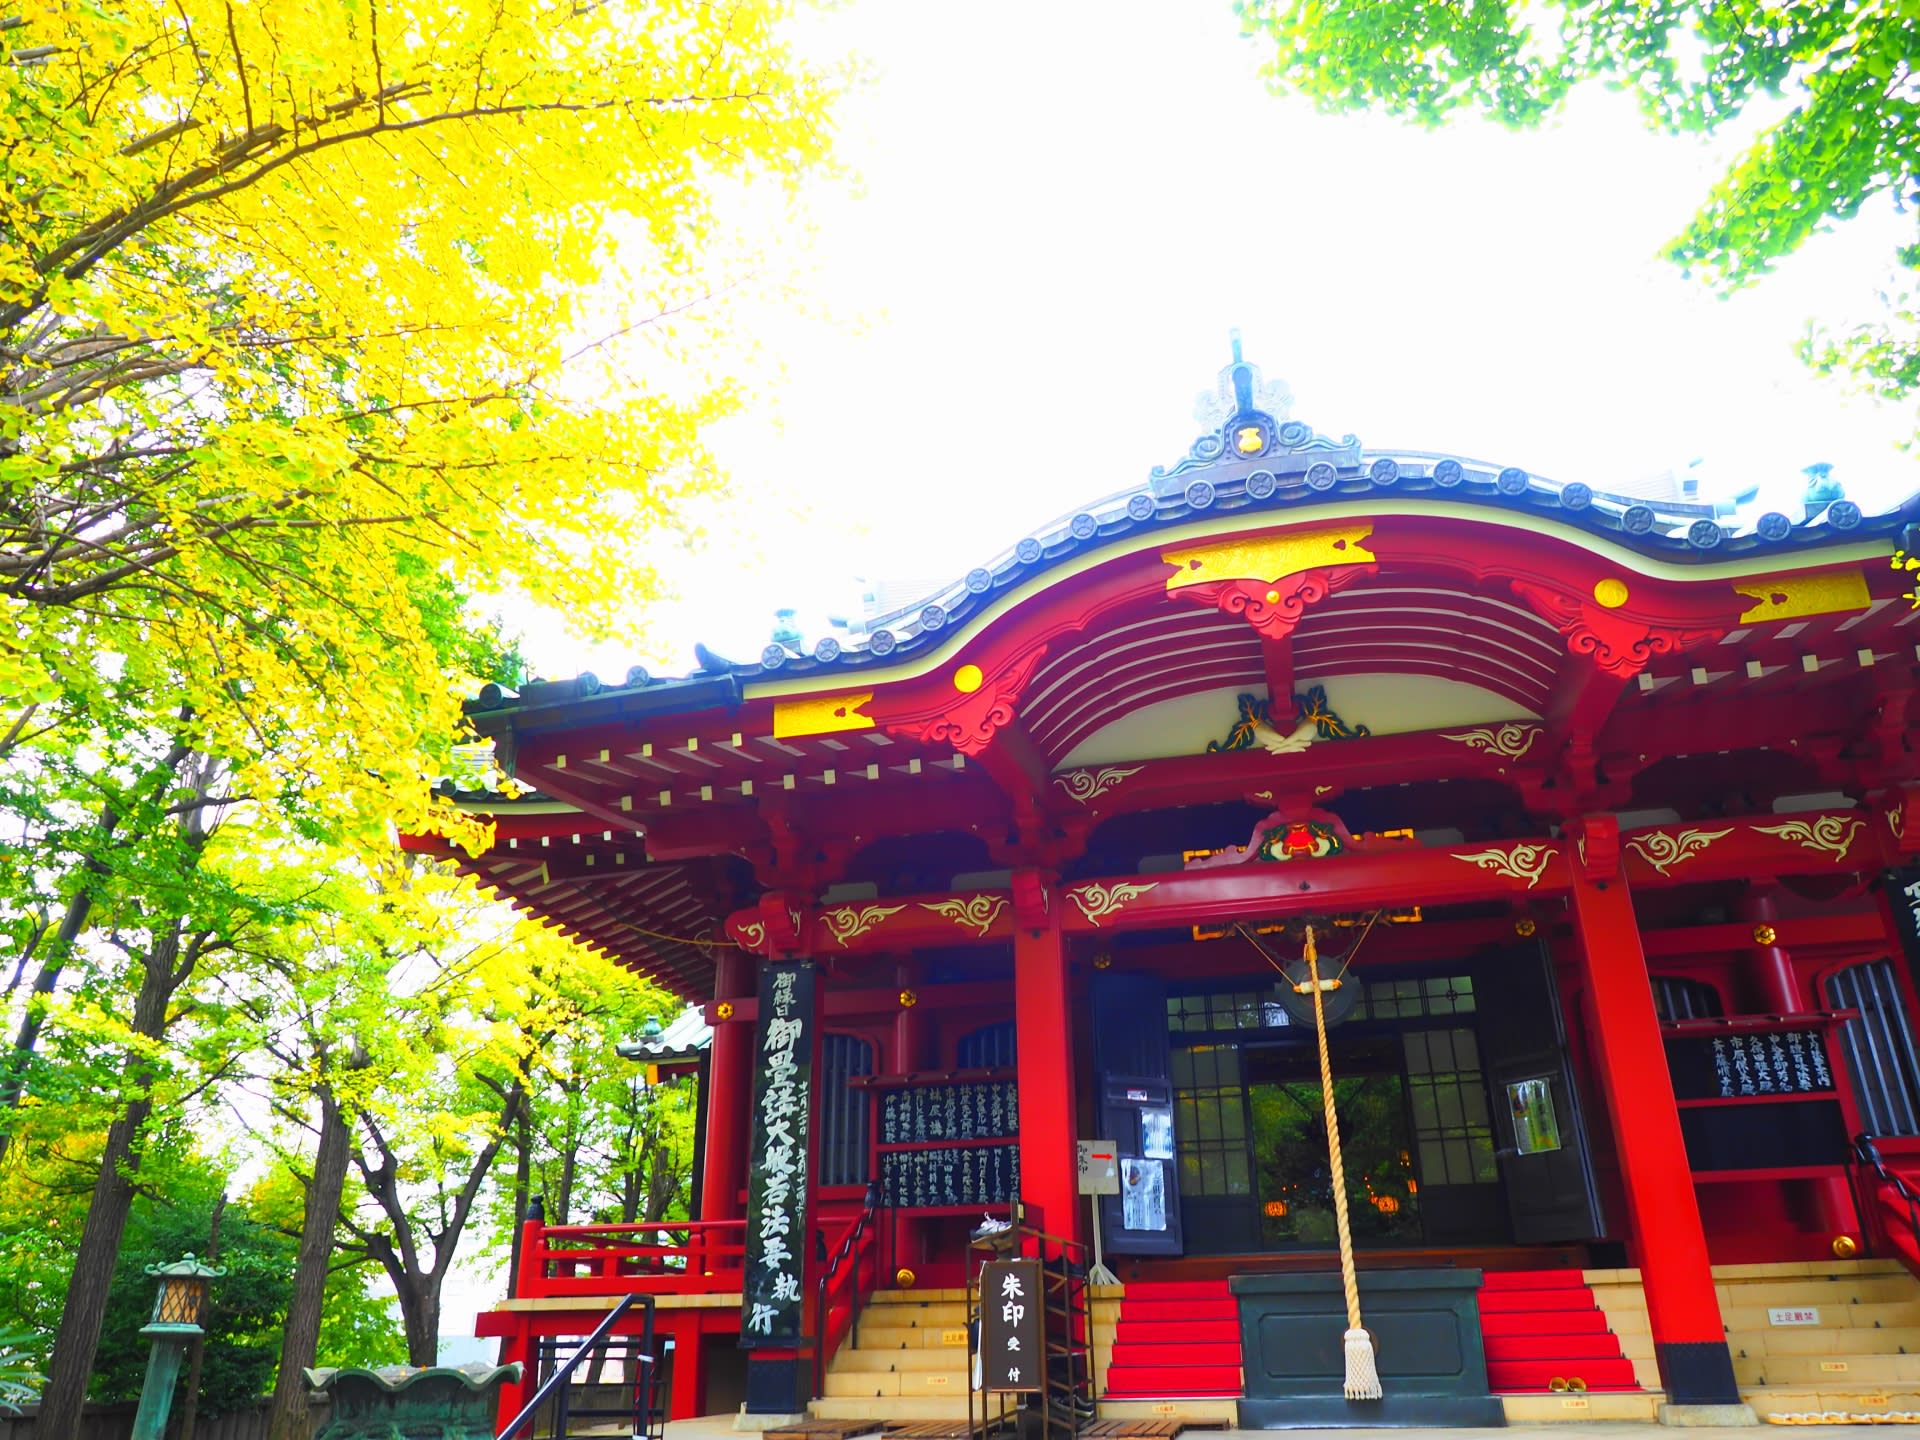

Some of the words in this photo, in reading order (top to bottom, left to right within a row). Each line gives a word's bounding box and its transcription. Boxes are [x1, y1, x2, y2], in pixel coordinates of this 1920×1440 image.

[1775, 1310, 1814, 1323] 土足厳禁
[944, 1332, 968, 1343] 土足厳
